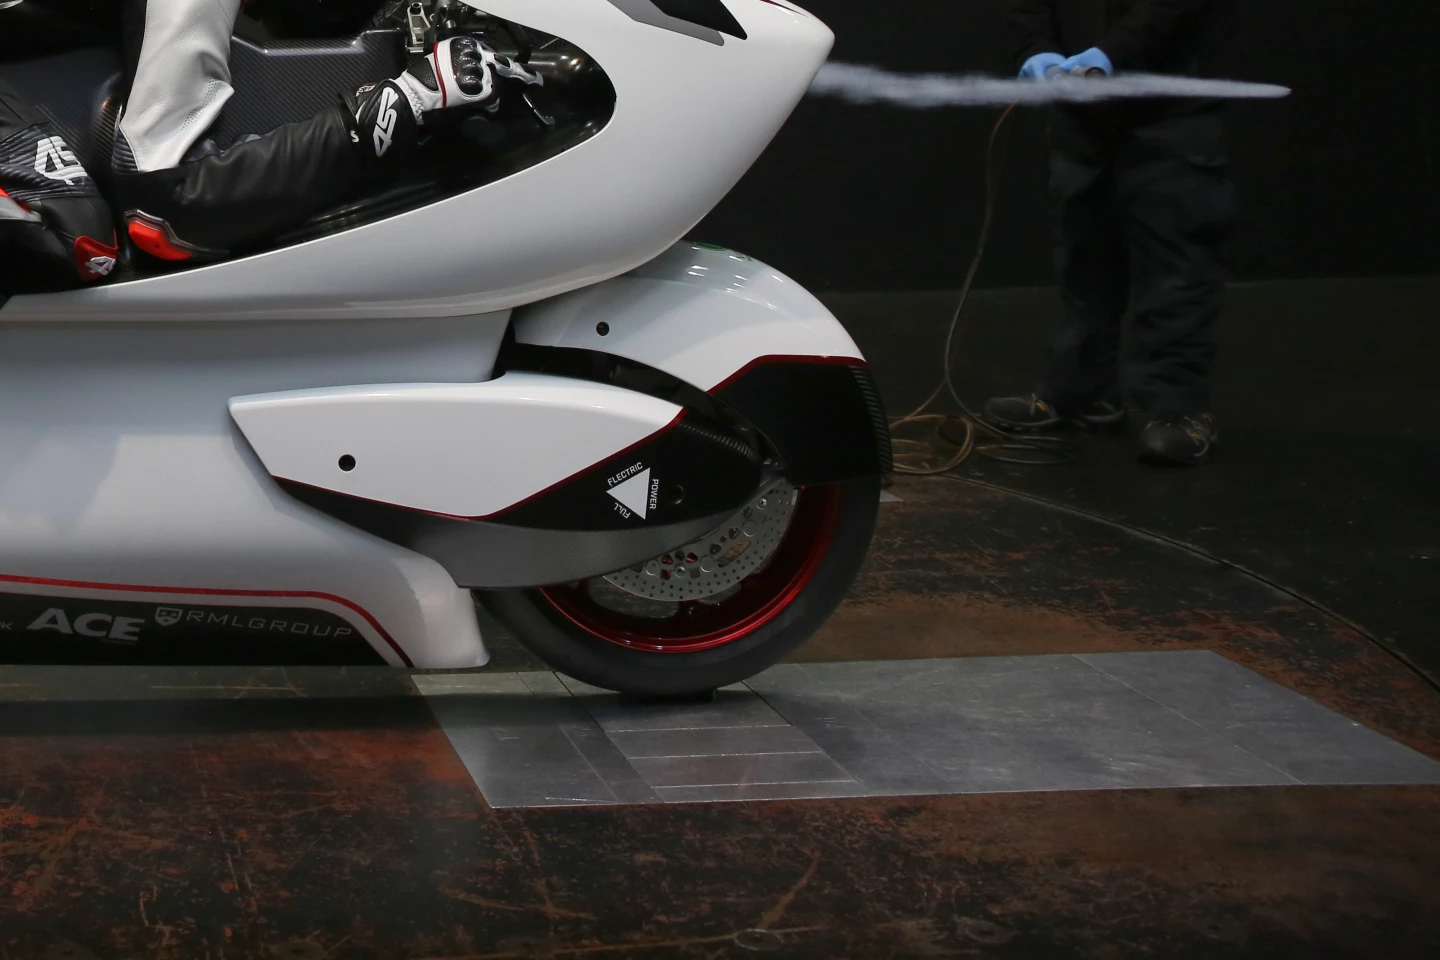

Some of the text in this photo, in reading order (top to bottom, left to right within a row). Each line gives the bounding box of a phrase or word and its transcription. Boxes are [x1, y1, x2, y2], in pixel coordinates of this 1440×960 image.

[649, 479, 660, 510] POWER
[613, 502, 631, 519] FULL
[26, 607, 146, 641] ACE
